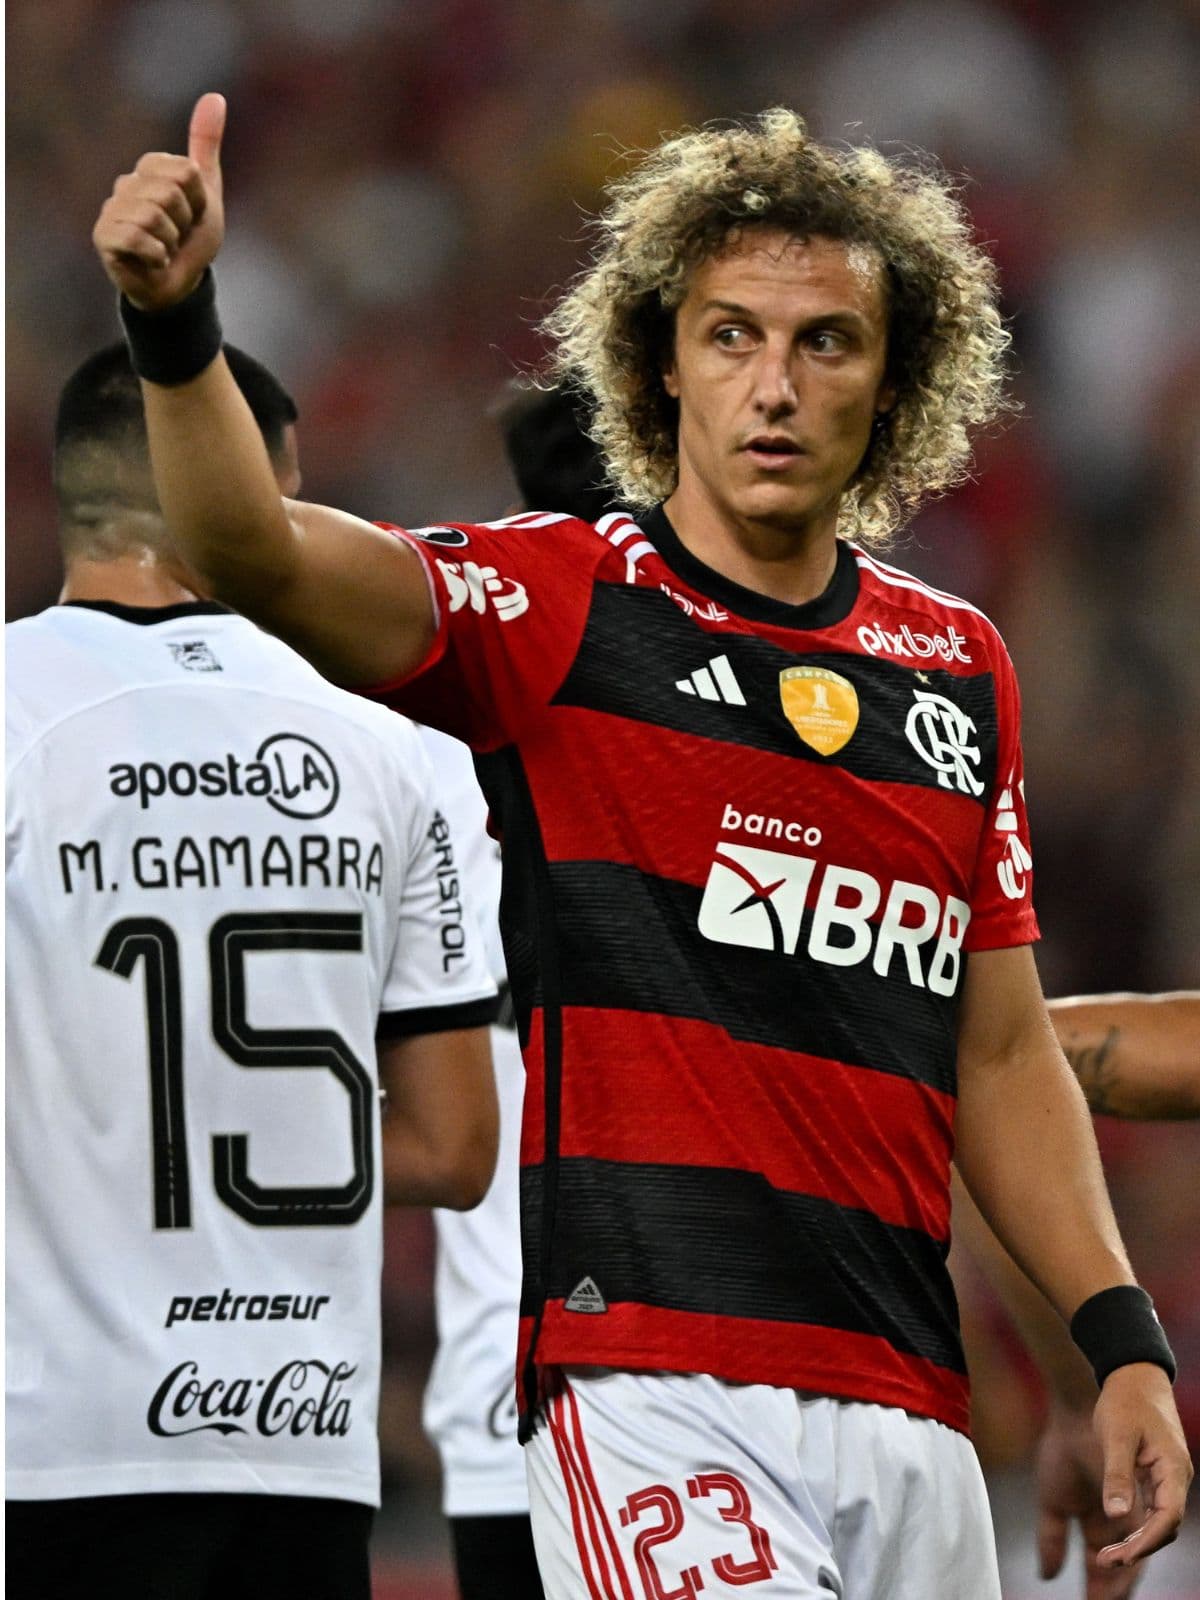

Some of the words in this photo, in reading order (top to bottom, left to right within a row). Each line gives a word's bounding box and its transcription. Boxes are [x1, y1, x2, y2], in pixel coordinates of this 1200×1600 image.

[856, 621, 973, 664] pixbet
[58, 840, 119, 894] M.
[131, 834, 384, 896] GAMARRA
[721, 804, 823, 847] banco
[430, 817, 466, 973] BRISTOL
[807, 863, 971, 997] BRB
[94, 910, 376, 1232] 15
[165, 1288, 331, 1328] petrosur
[617, 1472, 780, 1600] 23
